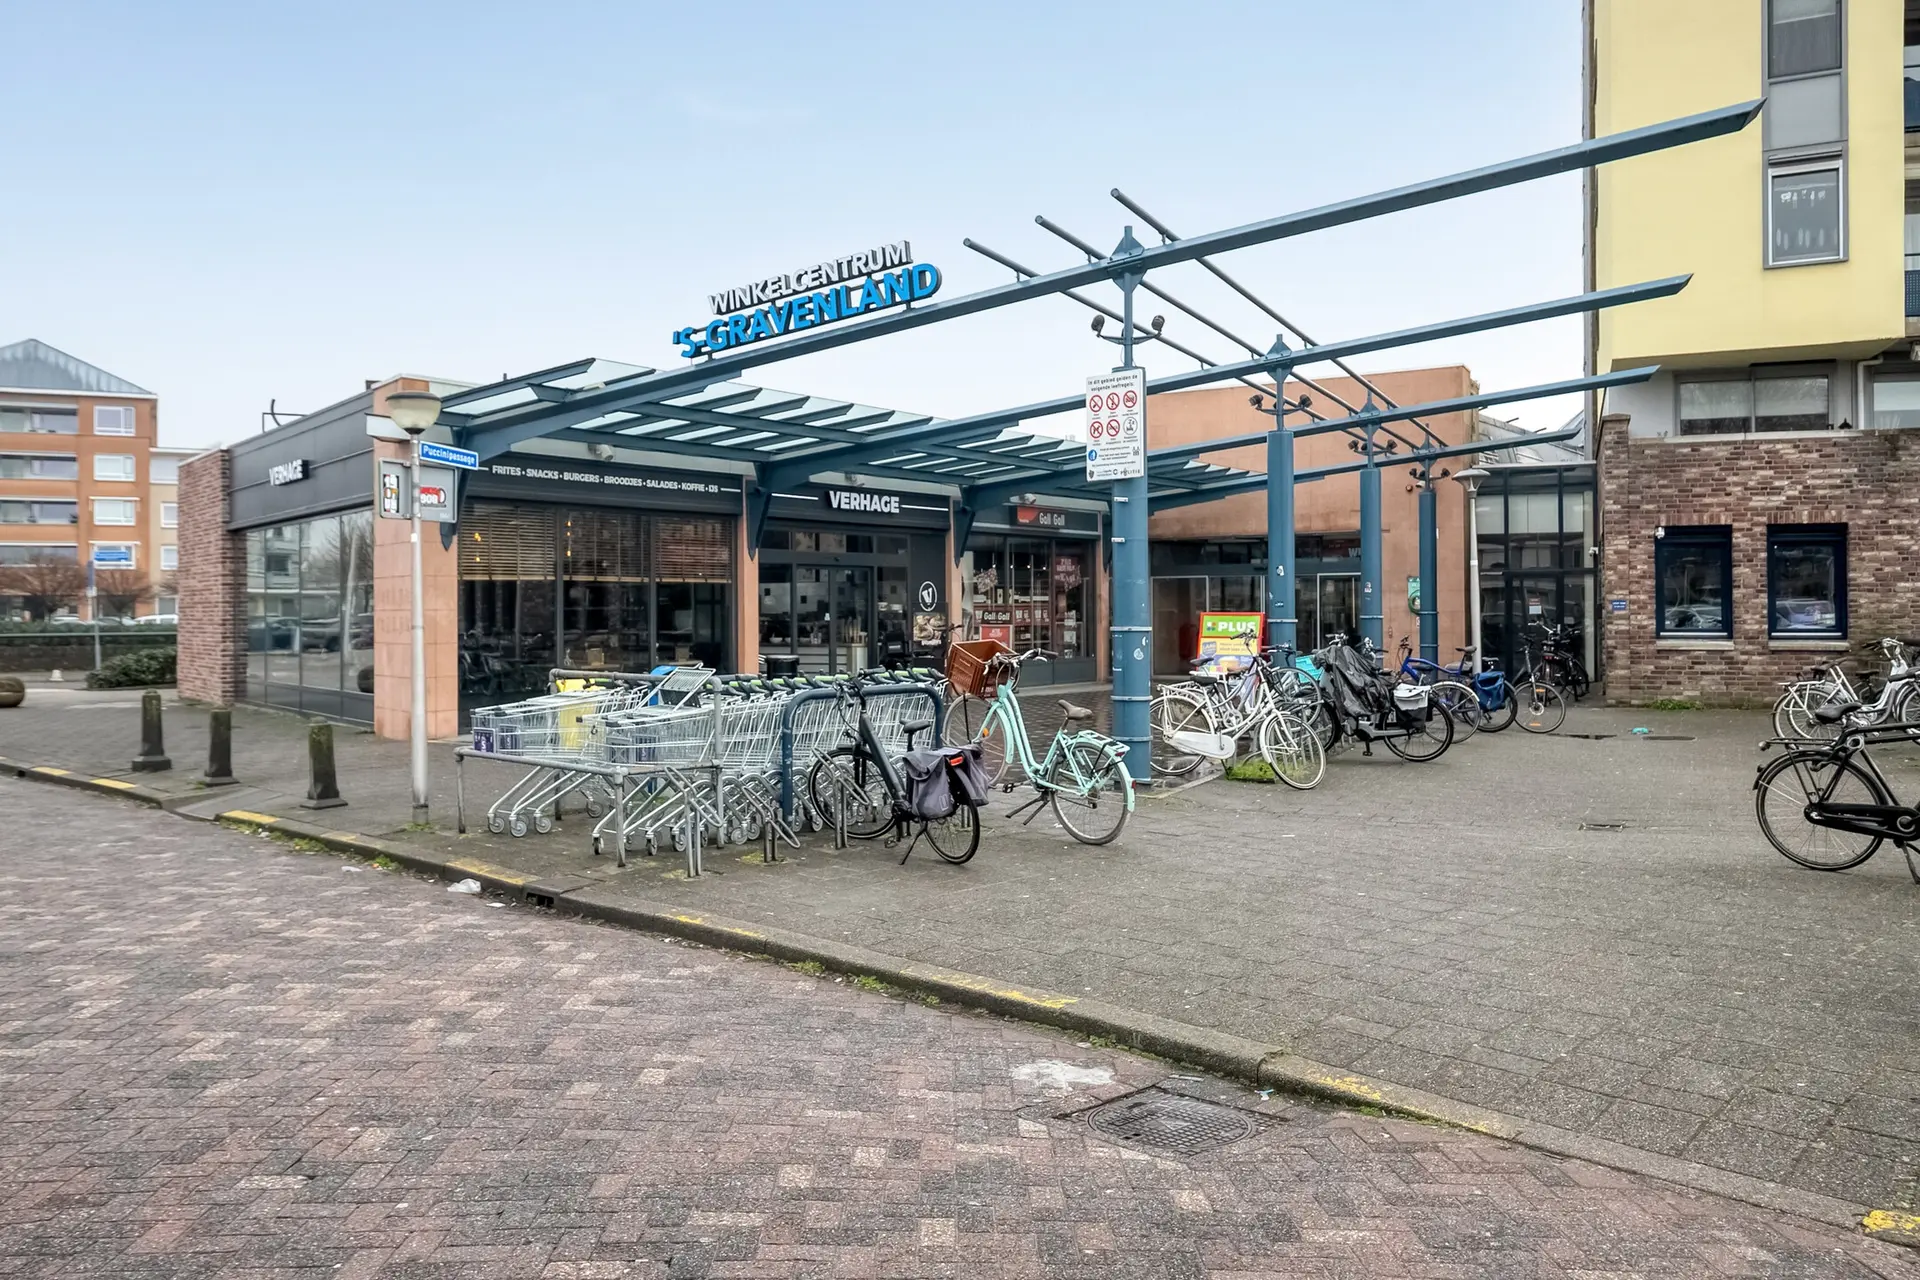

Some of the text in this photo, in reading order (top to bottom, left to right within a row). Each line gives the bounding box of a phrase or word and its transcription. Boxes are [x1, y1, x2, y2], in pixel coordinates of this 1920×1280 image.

[707, 240, 913, 316] WINKELCENTRUM
[423, 445, 476, 465] Puccinipassage
[268, 459, 303, 486] VERHAGE
[492, 465, 521, 476] FRITES
[526, 468, 559, 480] SNACKS
[563, 471, 600, 483] BURGERS
[604, 475, 642, 487] BROODJES
[646, 479, 678, 490] SALADES
[681, 482, 705, 492] KOFFIE
[829, 490, 900, 514] VERHAGE
[1039, 512, 1066, 526] Gall Gall
[983, 612, 996, 620] Gall
[1218, 621, 1256, 632] PLUS
